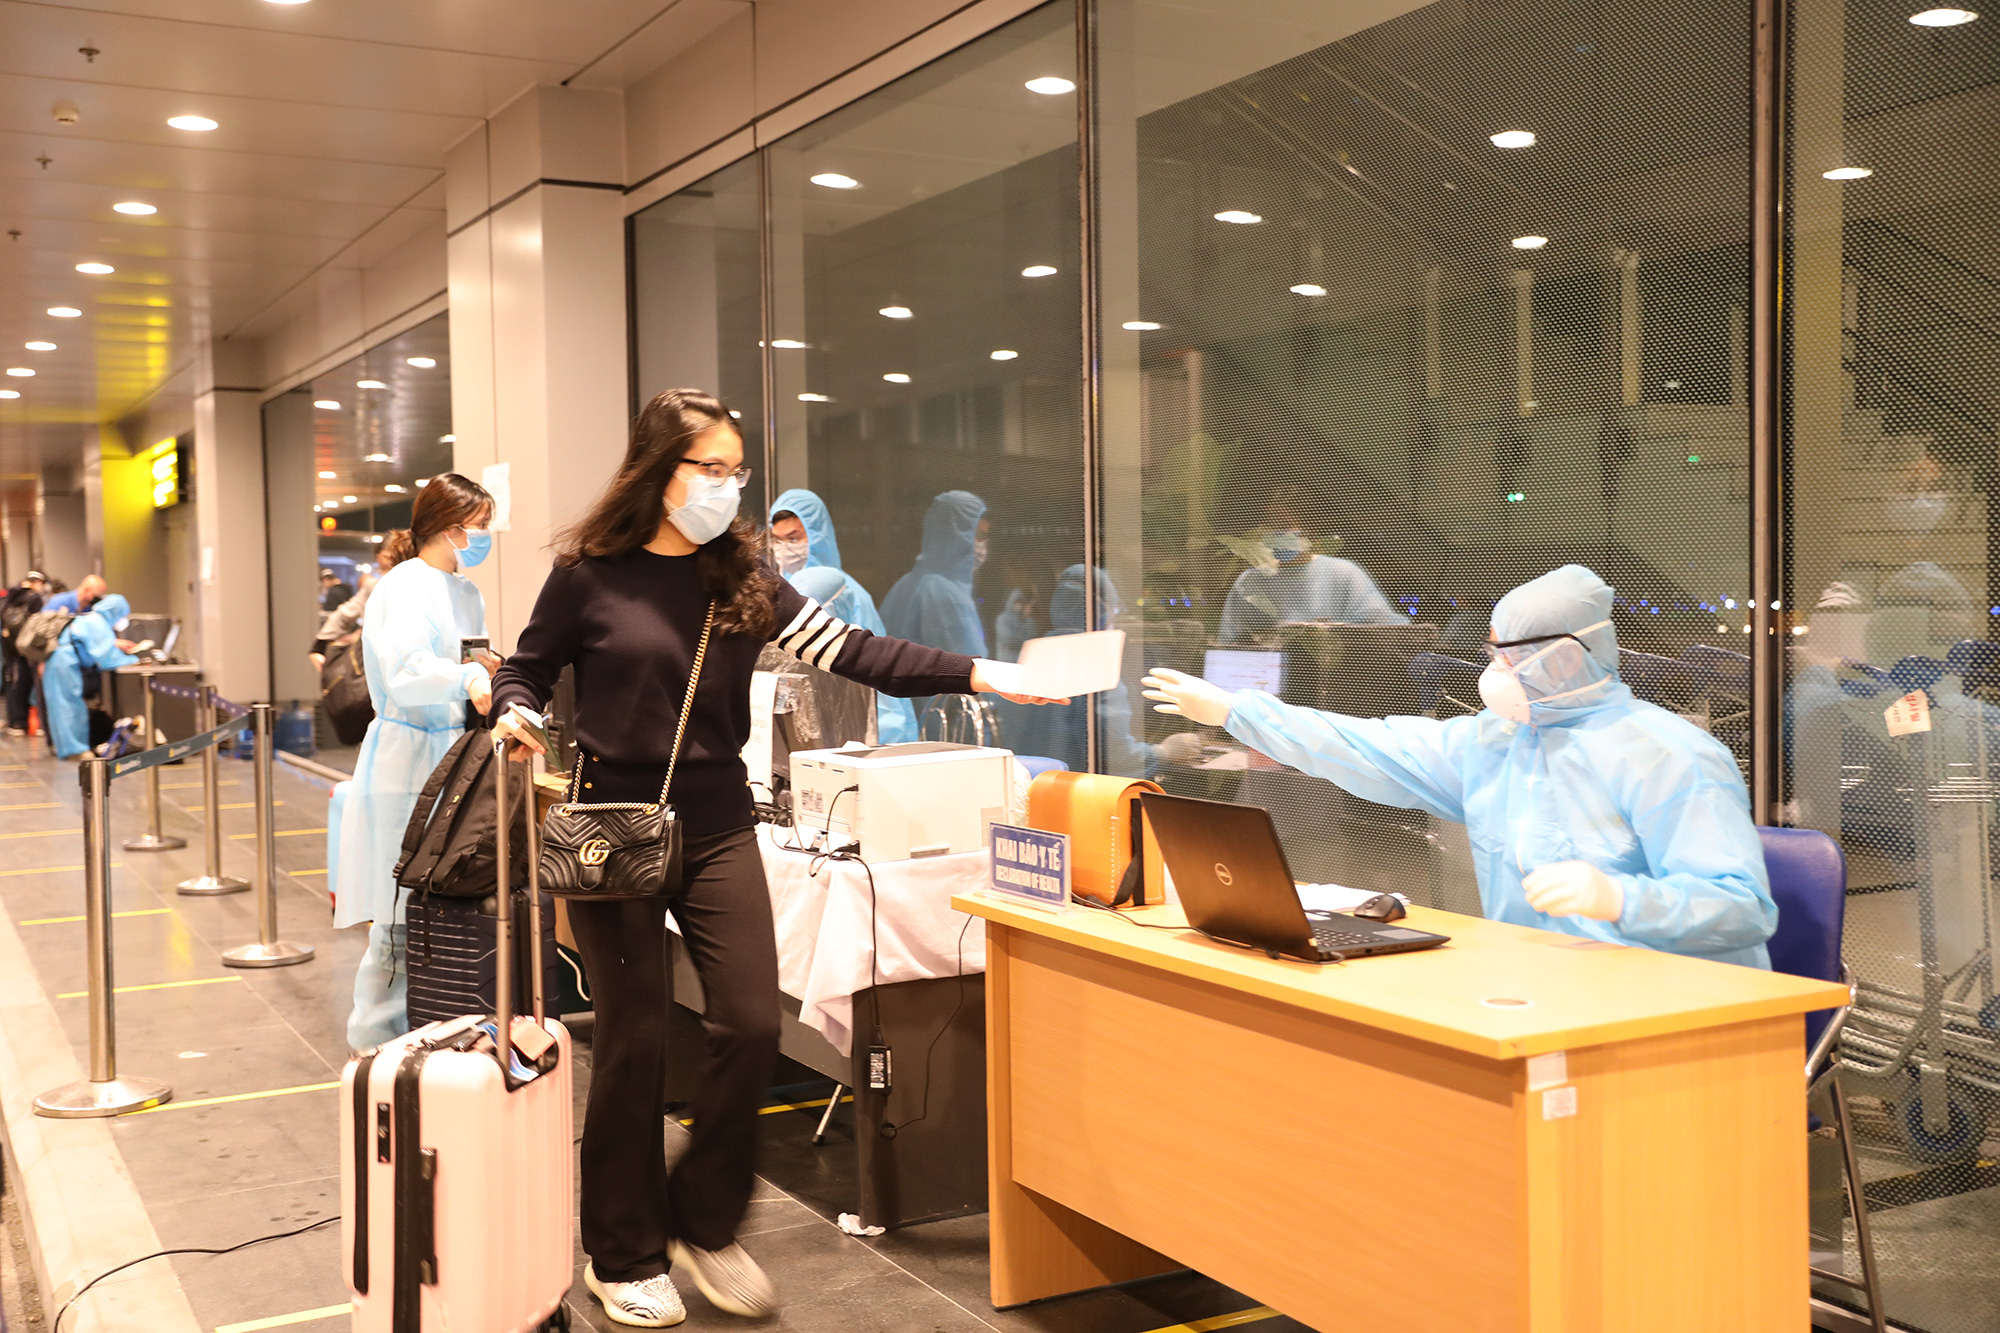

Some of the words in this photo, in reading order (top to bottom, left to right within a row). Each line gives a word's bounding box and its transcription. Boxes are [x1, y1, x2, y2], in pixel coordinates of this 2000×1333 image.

[995, 836, 1017, 862] KHAI
[1018, 839, 1038, 866] BÁO
[1039, 845, 1047, 868] Y
[1047, 842, 1061, 871] TẾ
